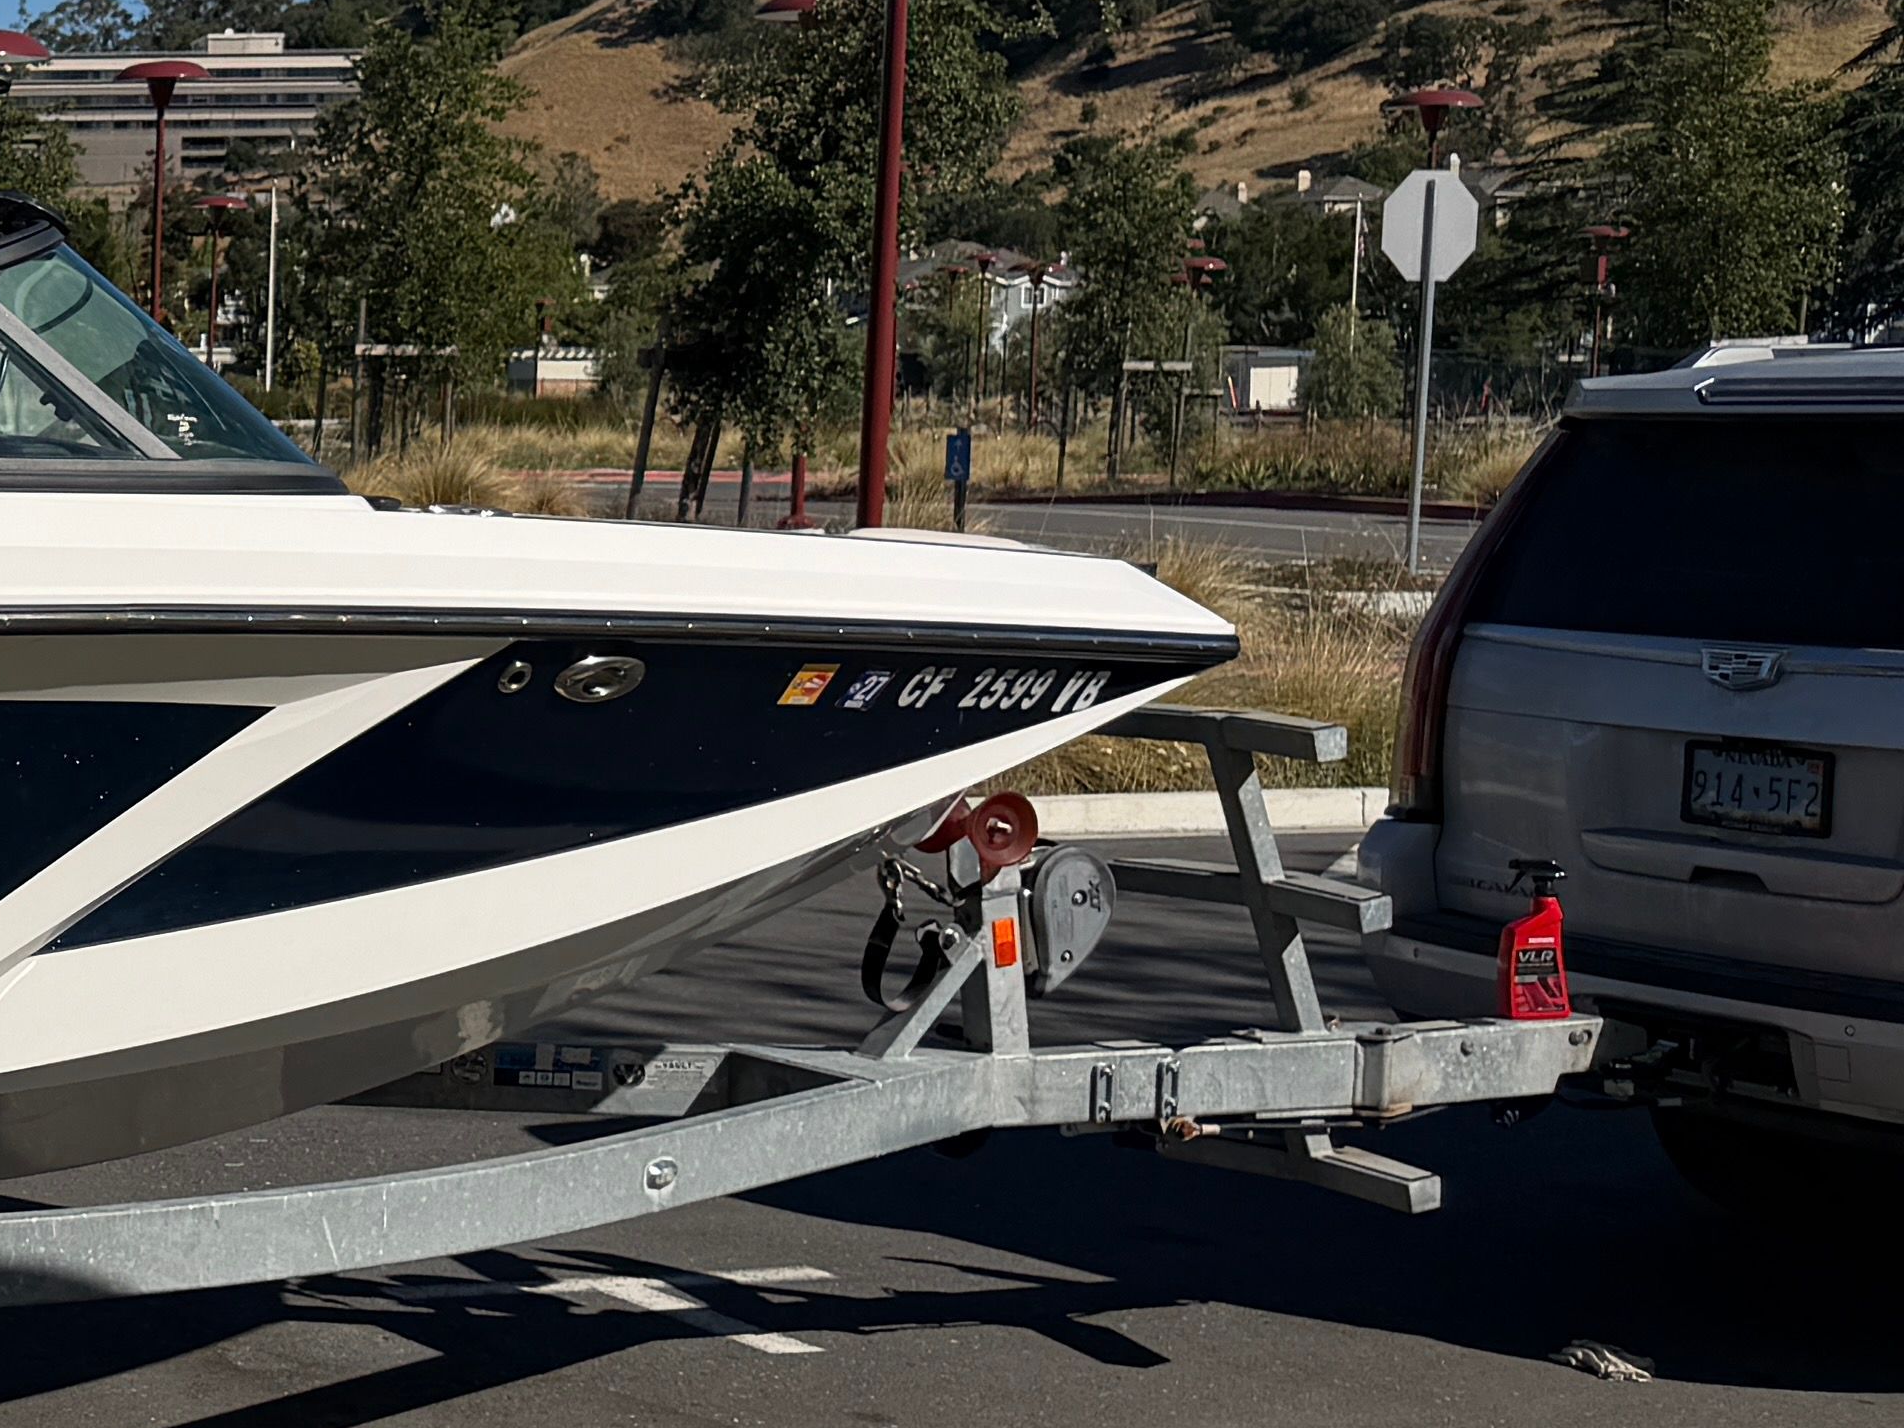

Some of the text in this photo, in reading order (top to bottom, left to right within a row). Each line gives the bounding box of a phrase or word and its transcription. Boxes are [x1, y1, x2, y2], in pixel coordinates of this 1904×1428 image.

[853, 675, 890, 702] 27
[897, 666, 958, 709] CF
[957, 667, 1058, 710] 2599
[1692, 770, 1820, 818] 914 5F2
[1518, 950, 1554, 963] VLR
